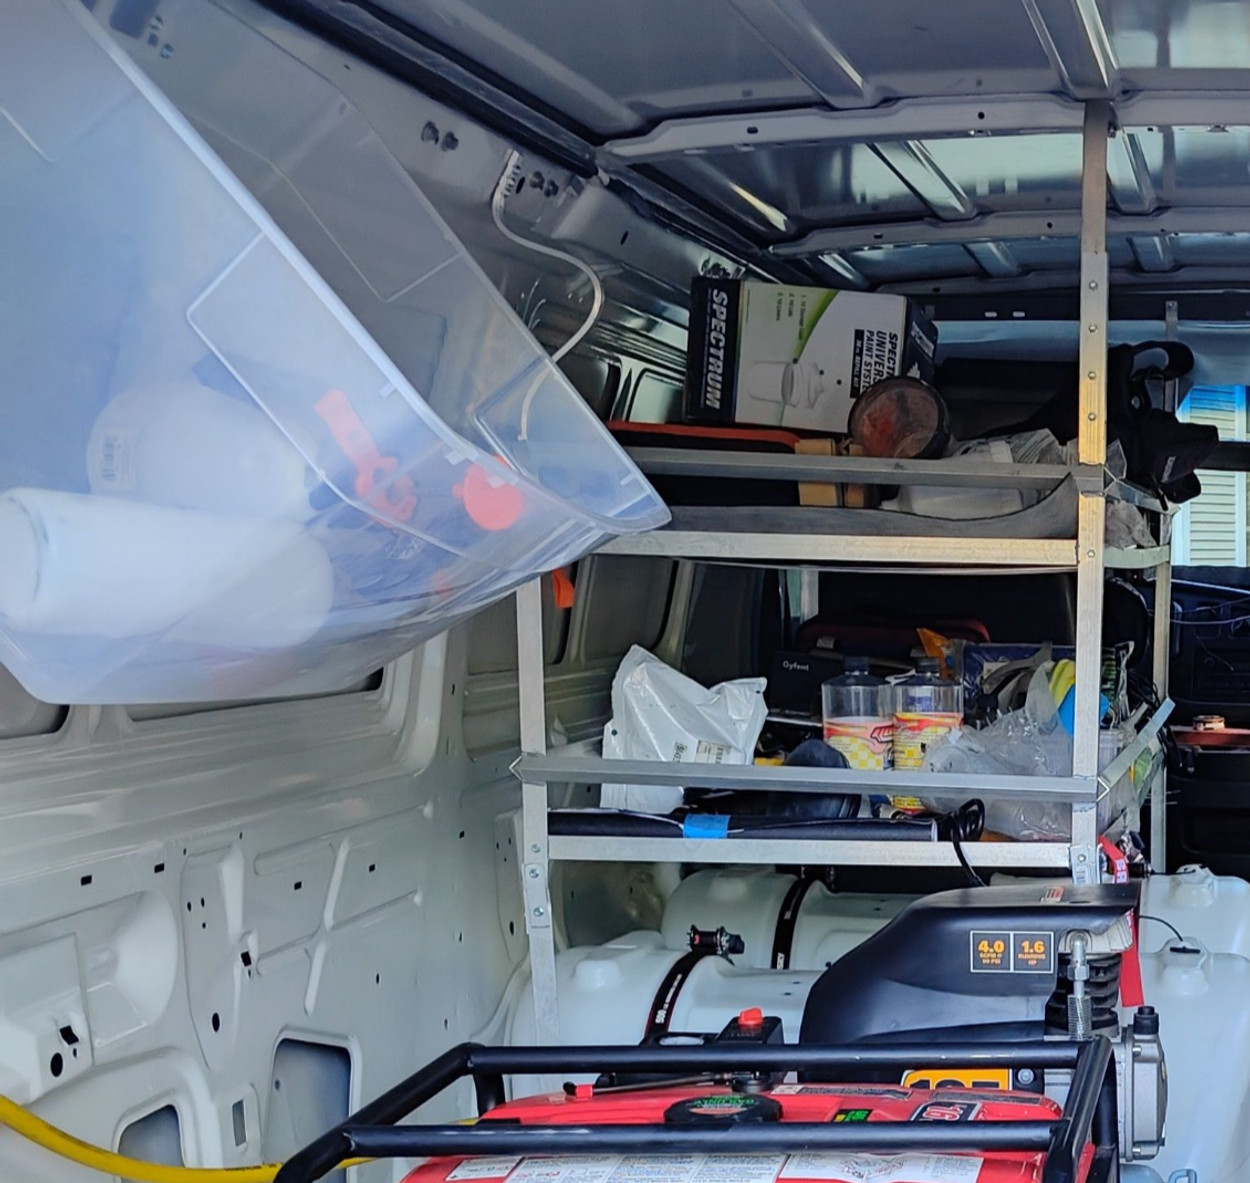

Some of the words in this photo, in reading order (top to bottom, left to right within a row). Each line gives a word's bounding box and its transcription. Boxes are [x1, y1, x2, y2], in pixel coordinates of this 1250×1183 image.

[706, 288, 729, 410] SPECTRUM
[865, 329, 875, 359] PAINT
[978, 940, 1005, 953] 4.0
[1021, 940, 1045, 953] 1.6
